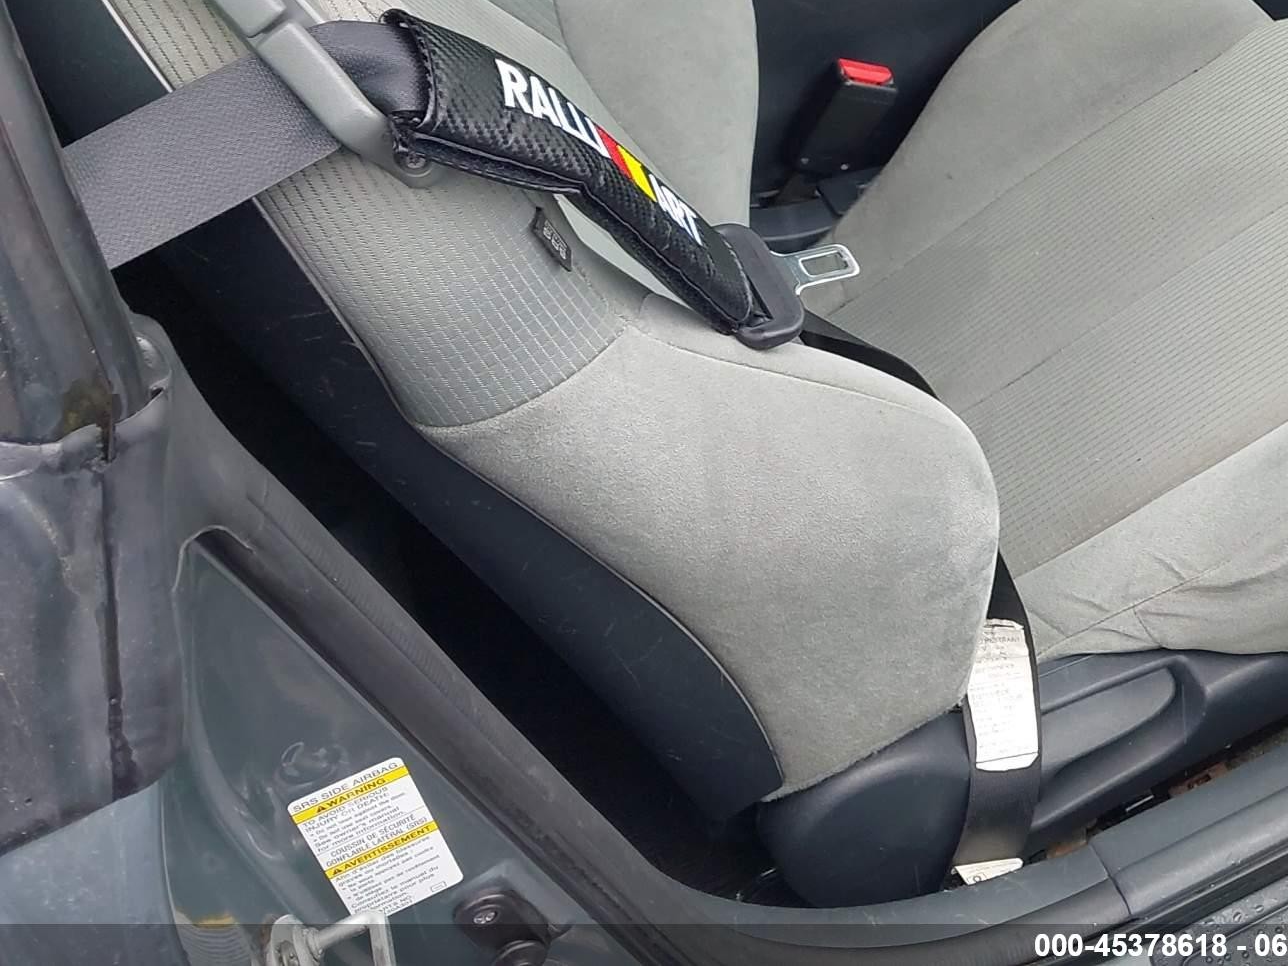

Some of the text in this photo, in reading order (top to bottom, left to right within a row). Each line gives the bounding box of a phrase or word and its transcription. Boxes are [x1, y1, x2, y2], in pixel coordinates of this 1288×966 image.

[293, 761, 398, 813] SRS SIDE AIRBAG
[327, 777, 386, 808] WARNING
[343, 826, 431, 869] AVERTISSEMENT
